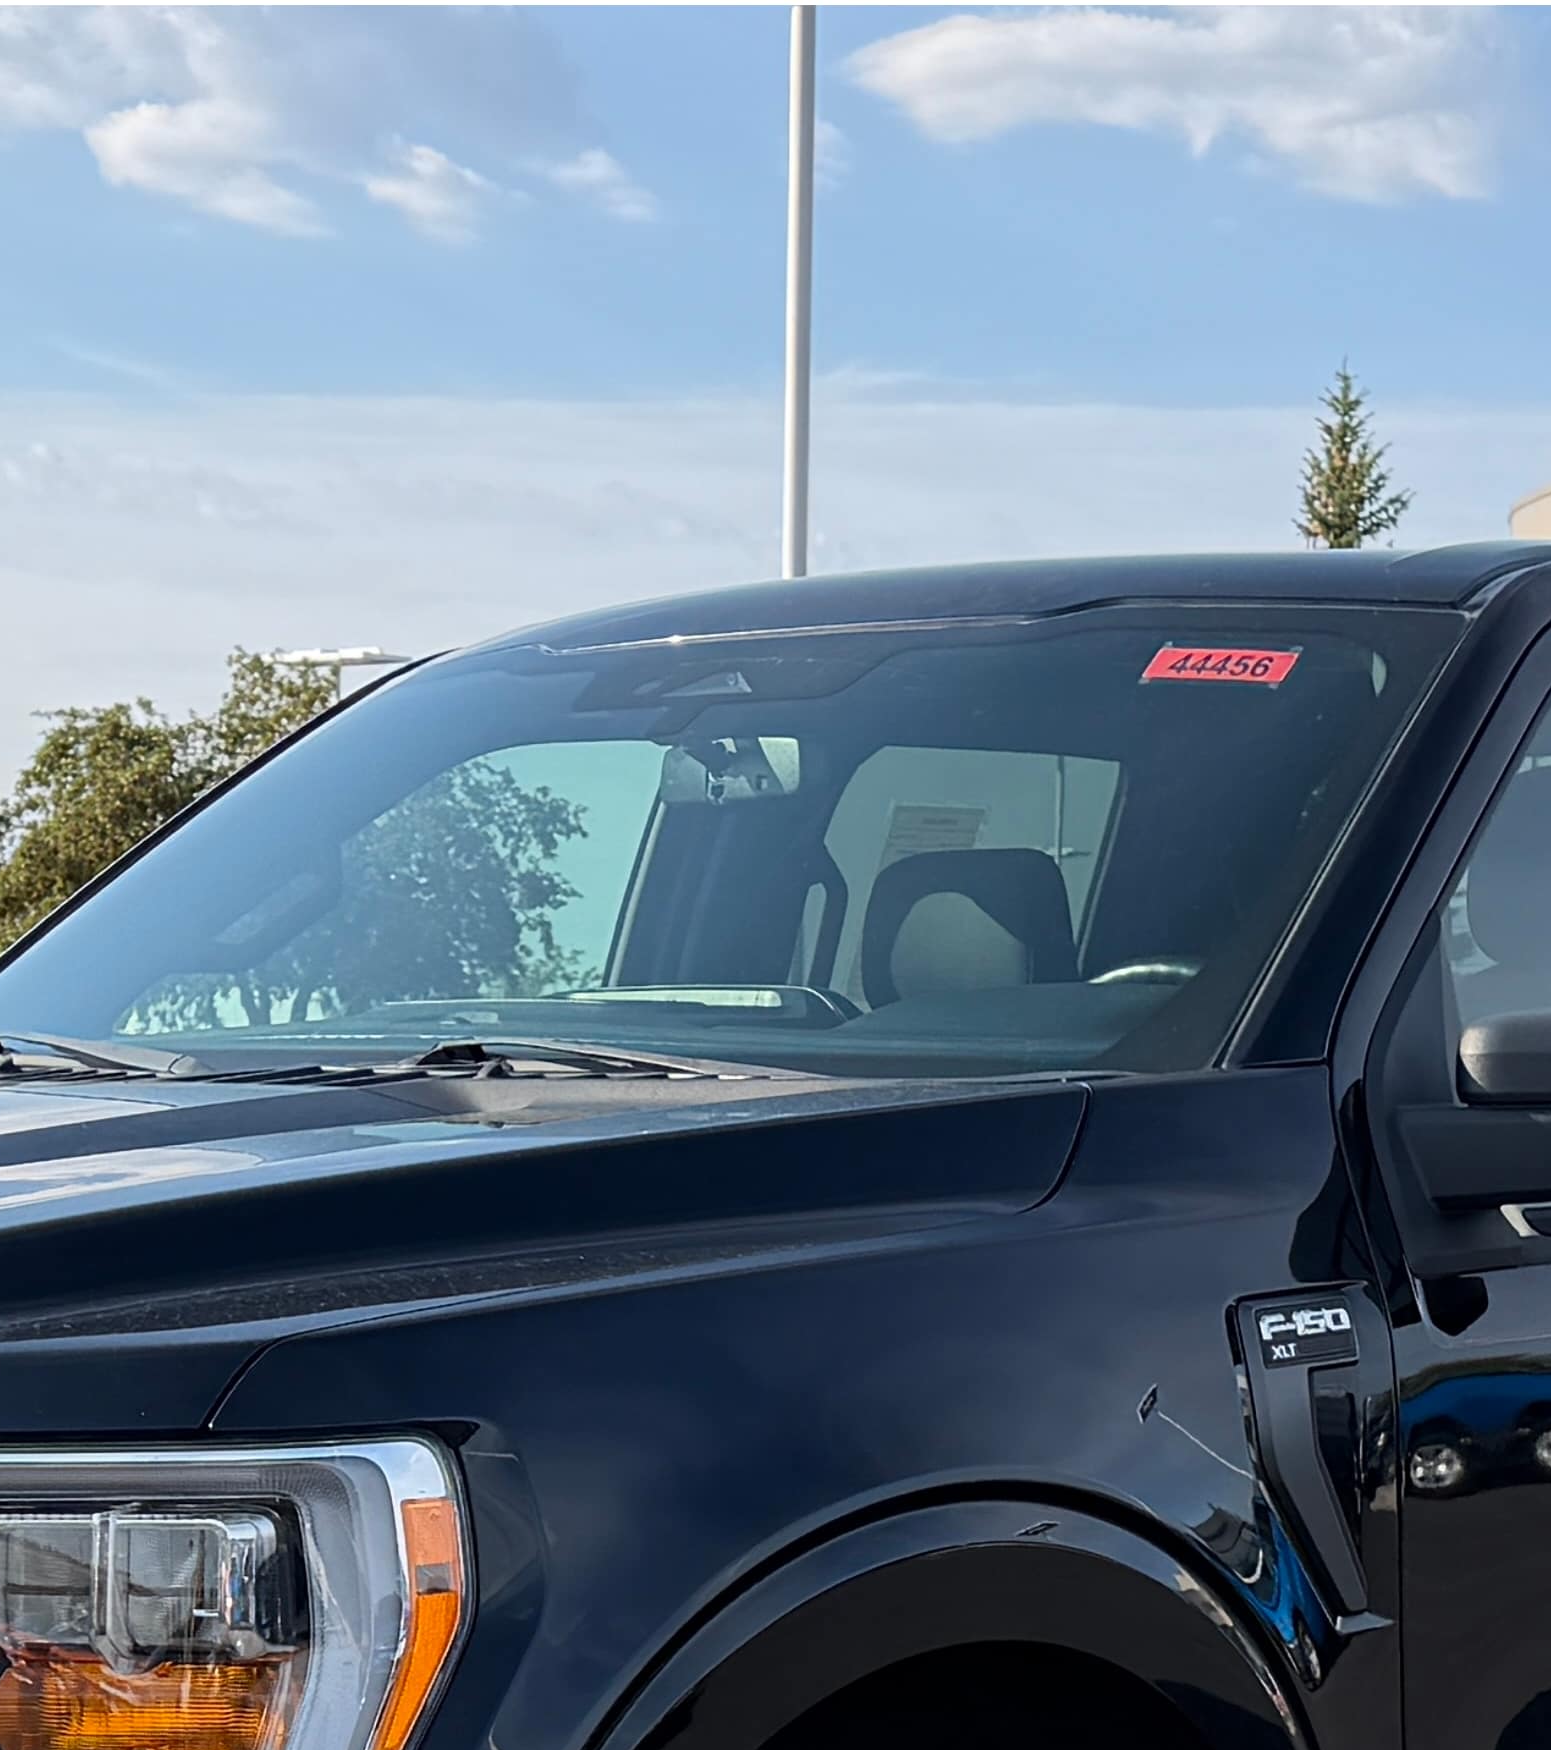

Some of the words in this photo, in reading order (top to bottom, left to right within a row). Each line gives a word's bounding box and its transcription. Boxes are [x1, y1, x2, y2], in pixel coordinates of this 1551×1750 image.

[1167, 653, 1274, 677] 44456
[1259, 1308, 1351, 1340] F-150
[1271, 1343, 1297, 1360] XLT
